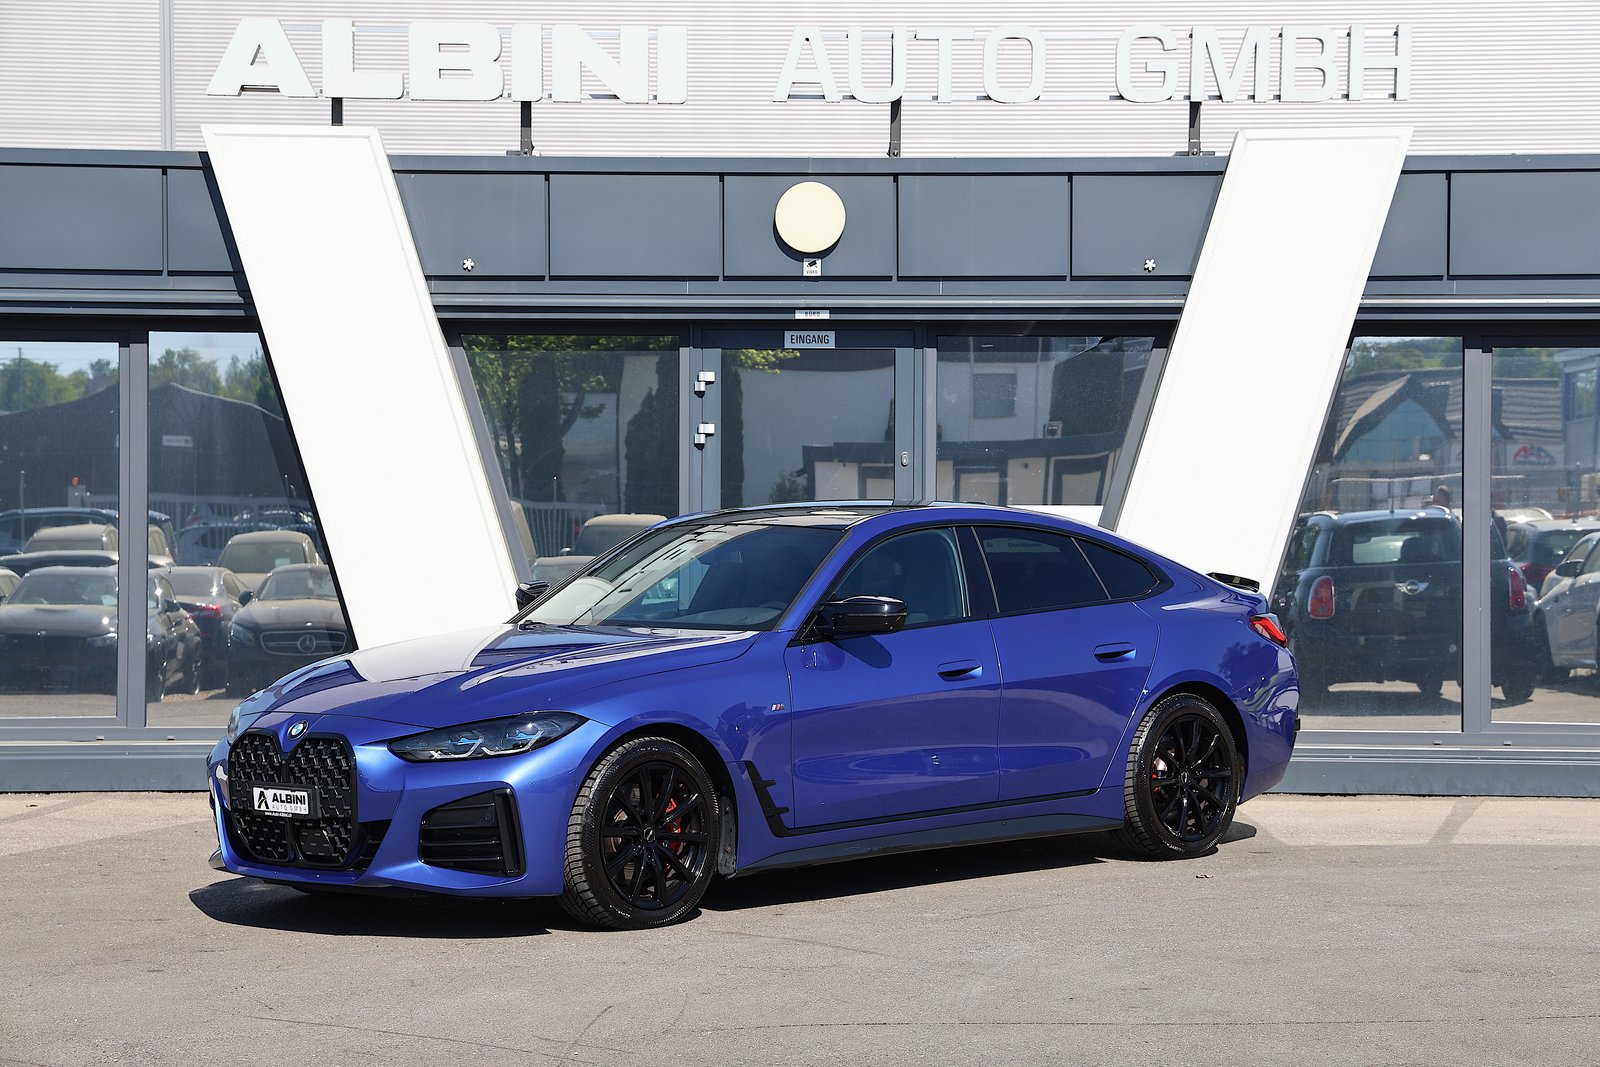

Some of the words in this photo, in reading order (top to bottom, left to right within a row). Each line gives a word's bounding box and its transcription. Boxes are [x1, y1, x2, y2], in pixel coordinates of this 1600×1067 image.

[206, 18, 688, 104] ALBINI
[773, 24, 1047, 104] AUTO
[1115, 24, 1413, 103] GMBH
[790, 334, 830, 344] EINGANG
[272, 792, 306, 805] ALBINI
